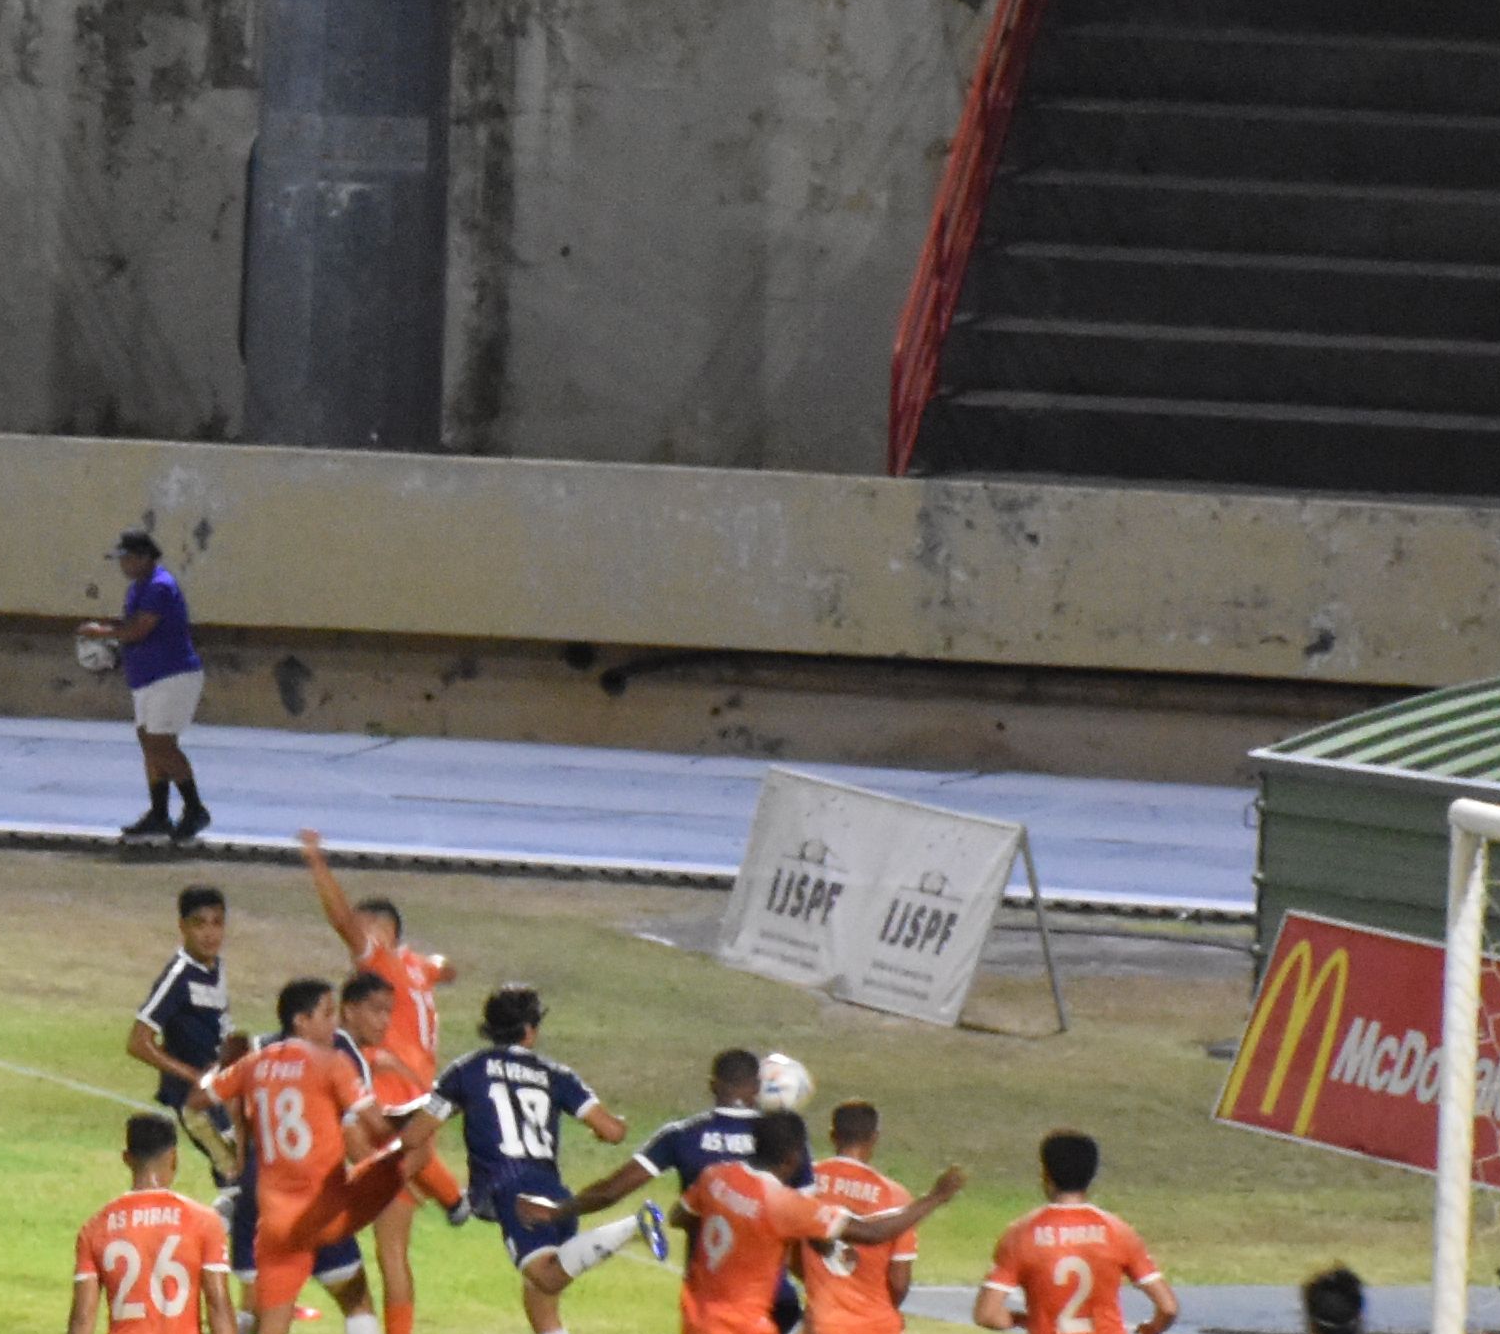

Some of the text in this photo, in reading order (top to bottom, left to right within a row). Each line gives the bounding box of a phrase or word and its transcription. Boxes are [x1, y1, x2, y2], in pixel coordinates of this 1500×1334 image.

[767, 867, 844, 924] IJSPF
[879, 898, 958, 955] IJSPF
[254, 1087, 312, 1163] 18
[701, 1131, 756, 1154] AS VEN
[107, 1207, 182, 1232] AS PIRAE
[103, 1234, 190, 1321] 26
[1053, 1255, 1095, 1334] 2
